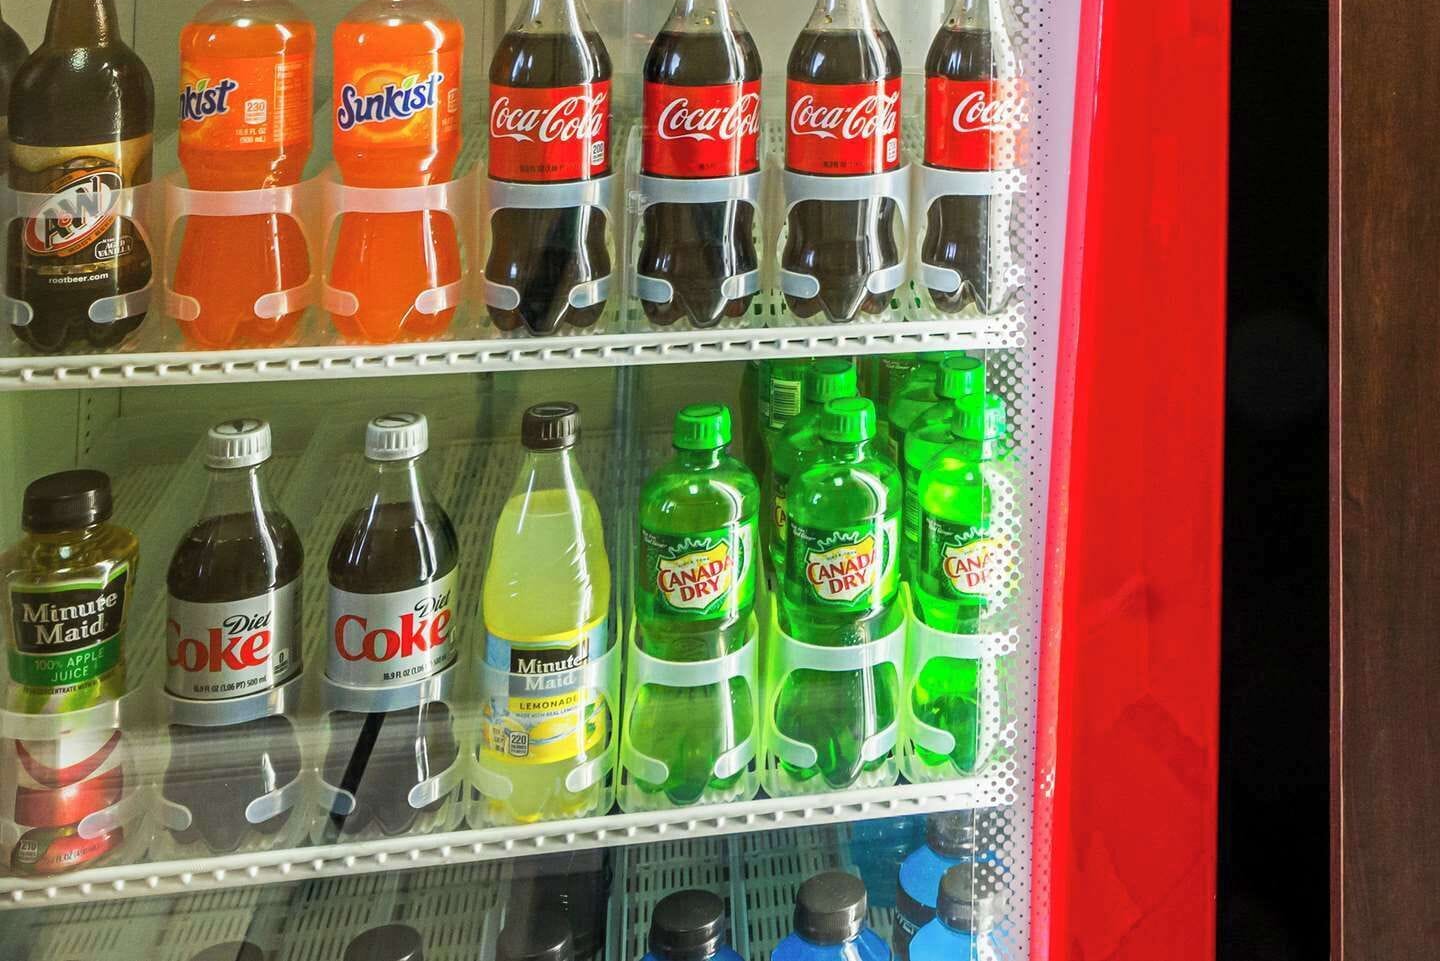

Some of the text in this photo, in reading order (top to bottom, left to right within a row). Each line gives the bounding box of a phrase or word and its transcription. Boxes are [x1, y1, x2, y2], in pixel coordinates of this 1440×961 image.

[180, 77, 239, 121] kist
[337, 72, 444, 131] Sunkist
[491, 91, 608, 143] Coca-Cola
[790, 91, 900, 141] Coca-Cola
[44, 174, 101, 250] A&W
[48, 272, 109, 284] rootbeer.com
[658, 555, 735, 593] CANADA
[679, 575, 721, 602] DRY
[828, 569, 868, 595] DRY
[21, 591, 118, 624] Minute
[414, 587, 451, 618] Diet
[35, 612, 105, 645] Maid
[222, 610, 272, 635] Diet
[334, 607, 452, 663] Coke
[66, 647, 105, 668] APPLE
[167, 618, 271, 672] Coke
[51, 665, 89, 682] JUICE
[517, 653, 583, 674] Minute
[524, 671, 577, 691] Maid
[511, 735, 527, 745] 220
